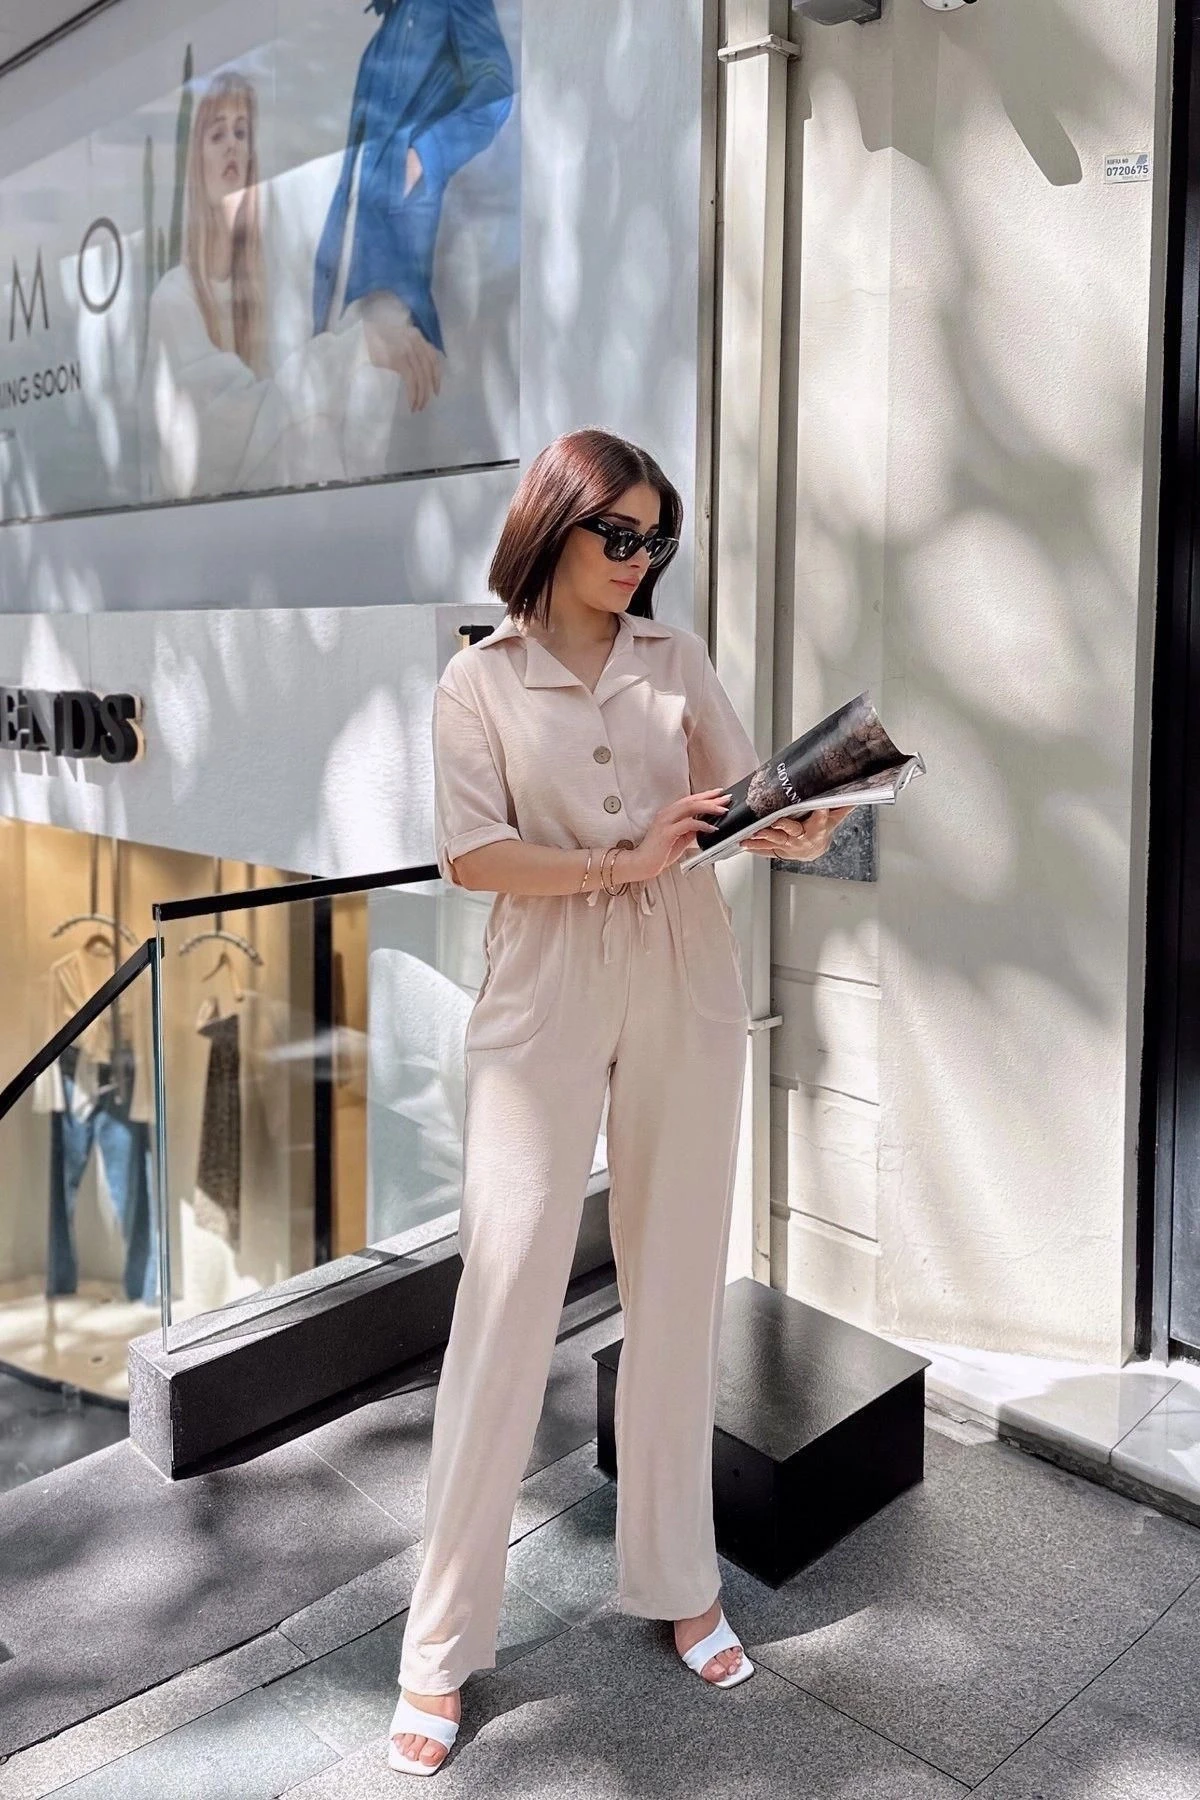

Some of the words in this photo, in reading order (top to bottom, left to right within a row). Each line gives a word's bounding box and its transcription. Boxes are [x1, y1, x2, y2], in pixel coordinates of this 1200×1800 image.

[1106, 164, 1149, 177] 0720675
[0, 376, 29, 409] ING
[32, 361, 81, 400] SOON
[0, 686, 139, 764] ENDS
